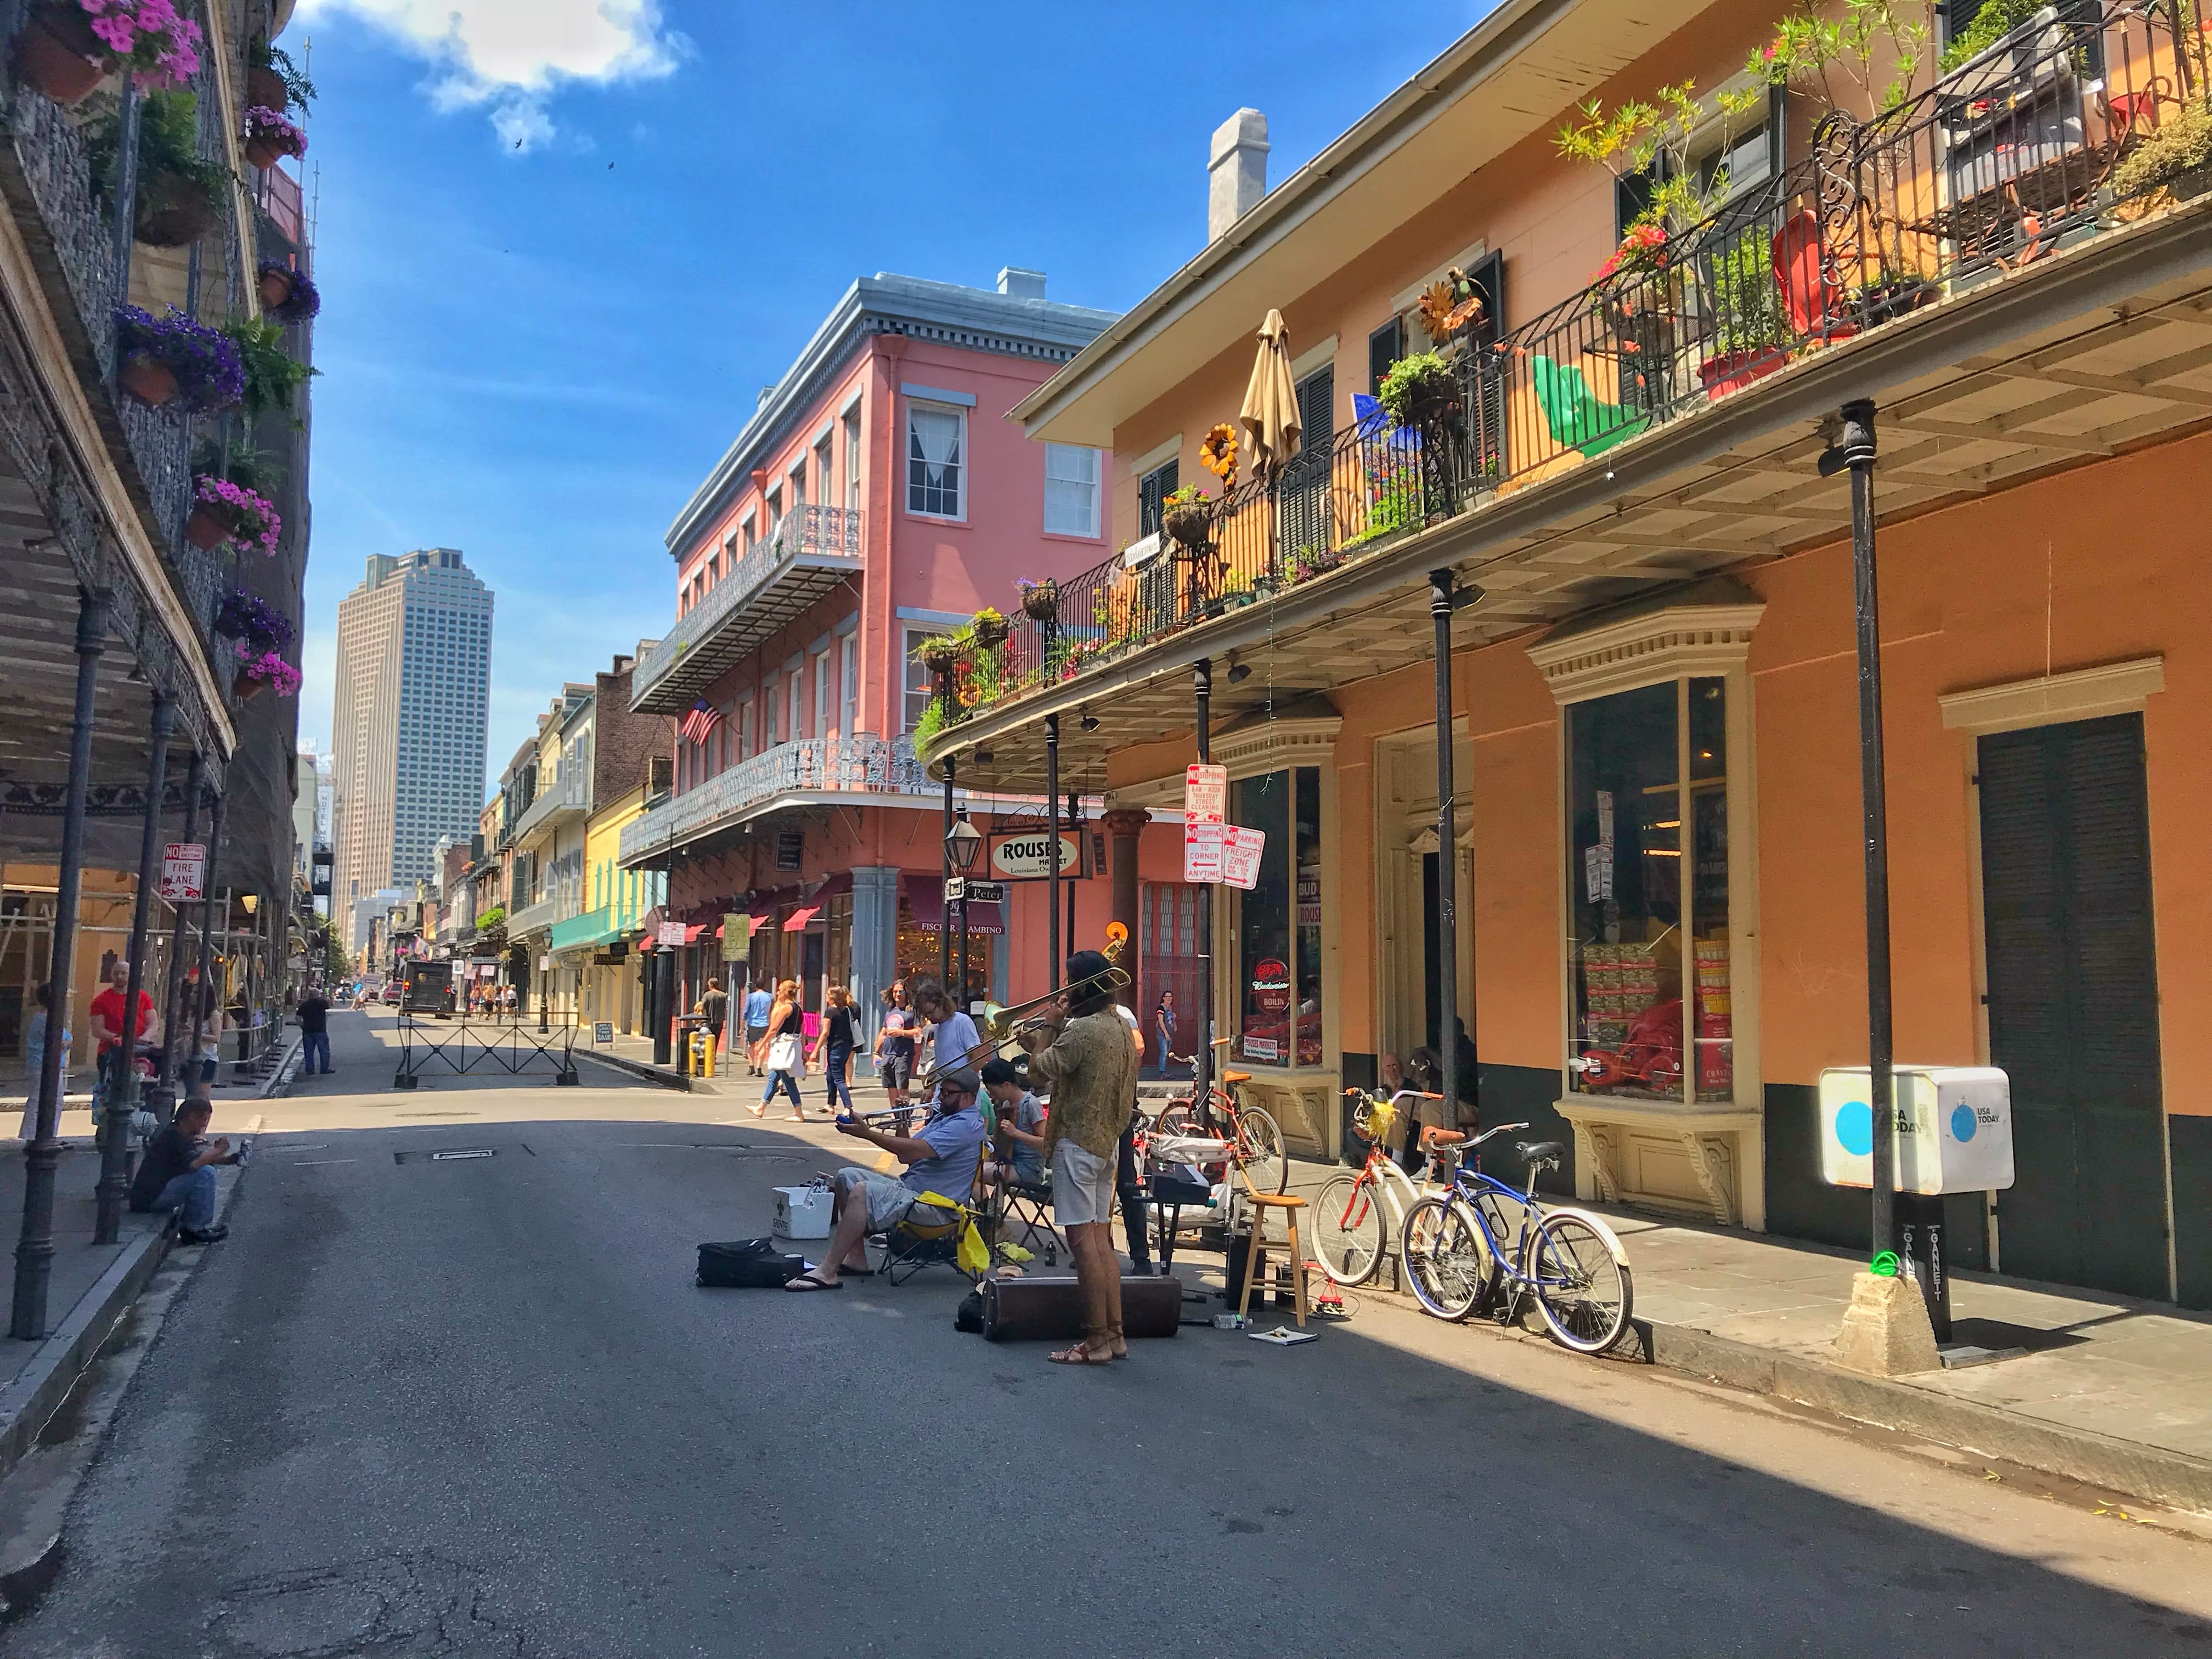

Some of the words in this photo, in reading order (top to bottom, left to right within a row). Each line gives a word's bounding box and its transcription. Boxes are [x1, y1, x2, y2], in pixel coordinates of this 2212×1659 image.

[1188, 770, 1199, 781] NO
[1187, 827, 1197, 839] NO
[1226, 830, 1237, 843] NO
[1237, 834, 1262, 845] PARKING
[166, 847, 179, 858] NO
[1226, 847, 1257, 860] FREIGHT
[1229, 856, 1250, 867] ZONE
[173, 863, 194, 872] FIRE
[171, 875, 194, 884] LANE
[974, 888, 1002, 899] Peter
[1299, 882, 1317, 896] BUD
[1892, 1109, 1906, 1120] SA
[1978, 1114, 2000, 1124] TODAY
[1892, 1121, 1923, 1134] ODAY
[1931, 1233, 1942, 1301] GANNETT
